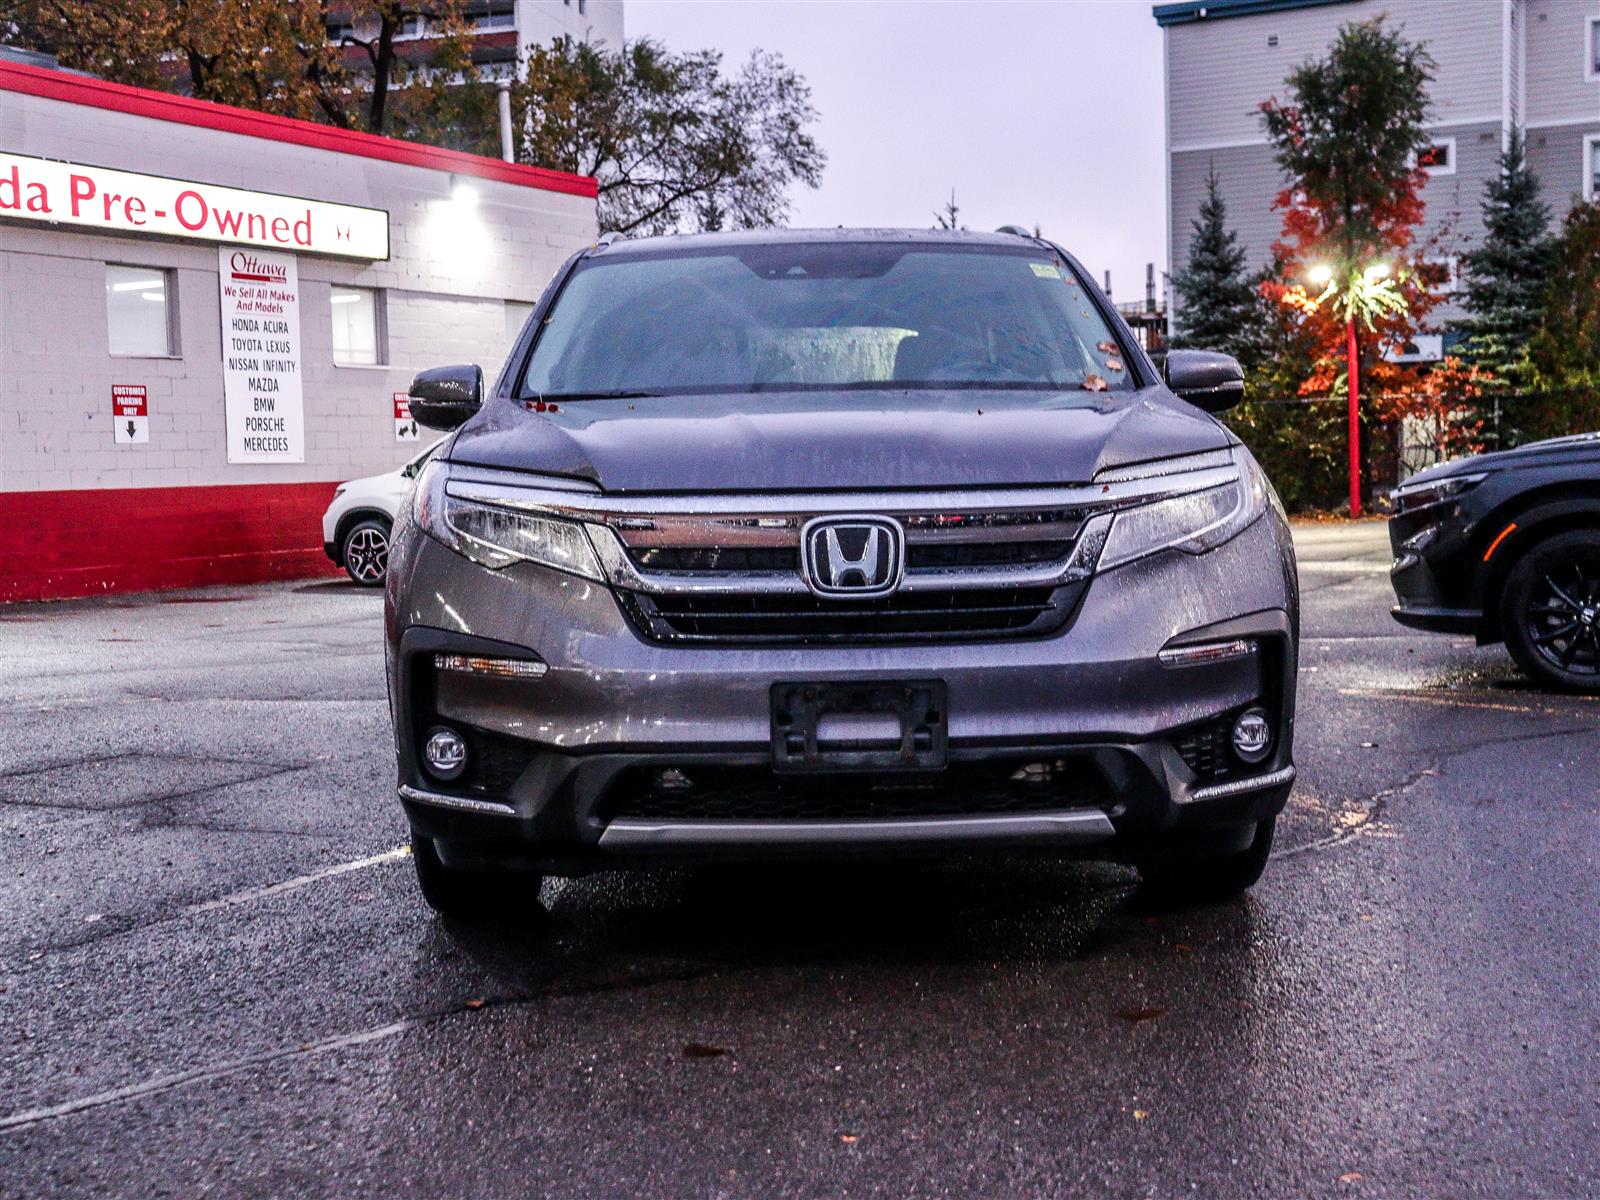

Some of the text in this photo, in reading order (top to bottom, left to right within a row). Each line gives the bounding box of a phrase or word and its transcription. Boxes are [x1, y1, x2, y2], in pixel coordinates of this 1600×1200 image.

[70, 174, 312, 246] Pre-Owned
[230, 251, 286, 276] Ottawa
[224, 286, 295, 302] We Sell All Makes
[236, 301, 283, 314] And Models
[231, 318, 289, 334] HONDA ACURA
[231, 338, 291, 354] TOYOTA LEXUS
[228, 357, 296, 373] NISSAN INFINITY
[113, 386, 145, 395] CUSTOMER
[248, 377, 279, 392] MAZDA
[117, 397, 142, 405] PARKING
[253, 397, 275, 412] BMW
[123, 407, 137, 415] ONLY
[245, 417, 285, 432] PORSCHE
[243, 437, 289, 452] MERCEDES
